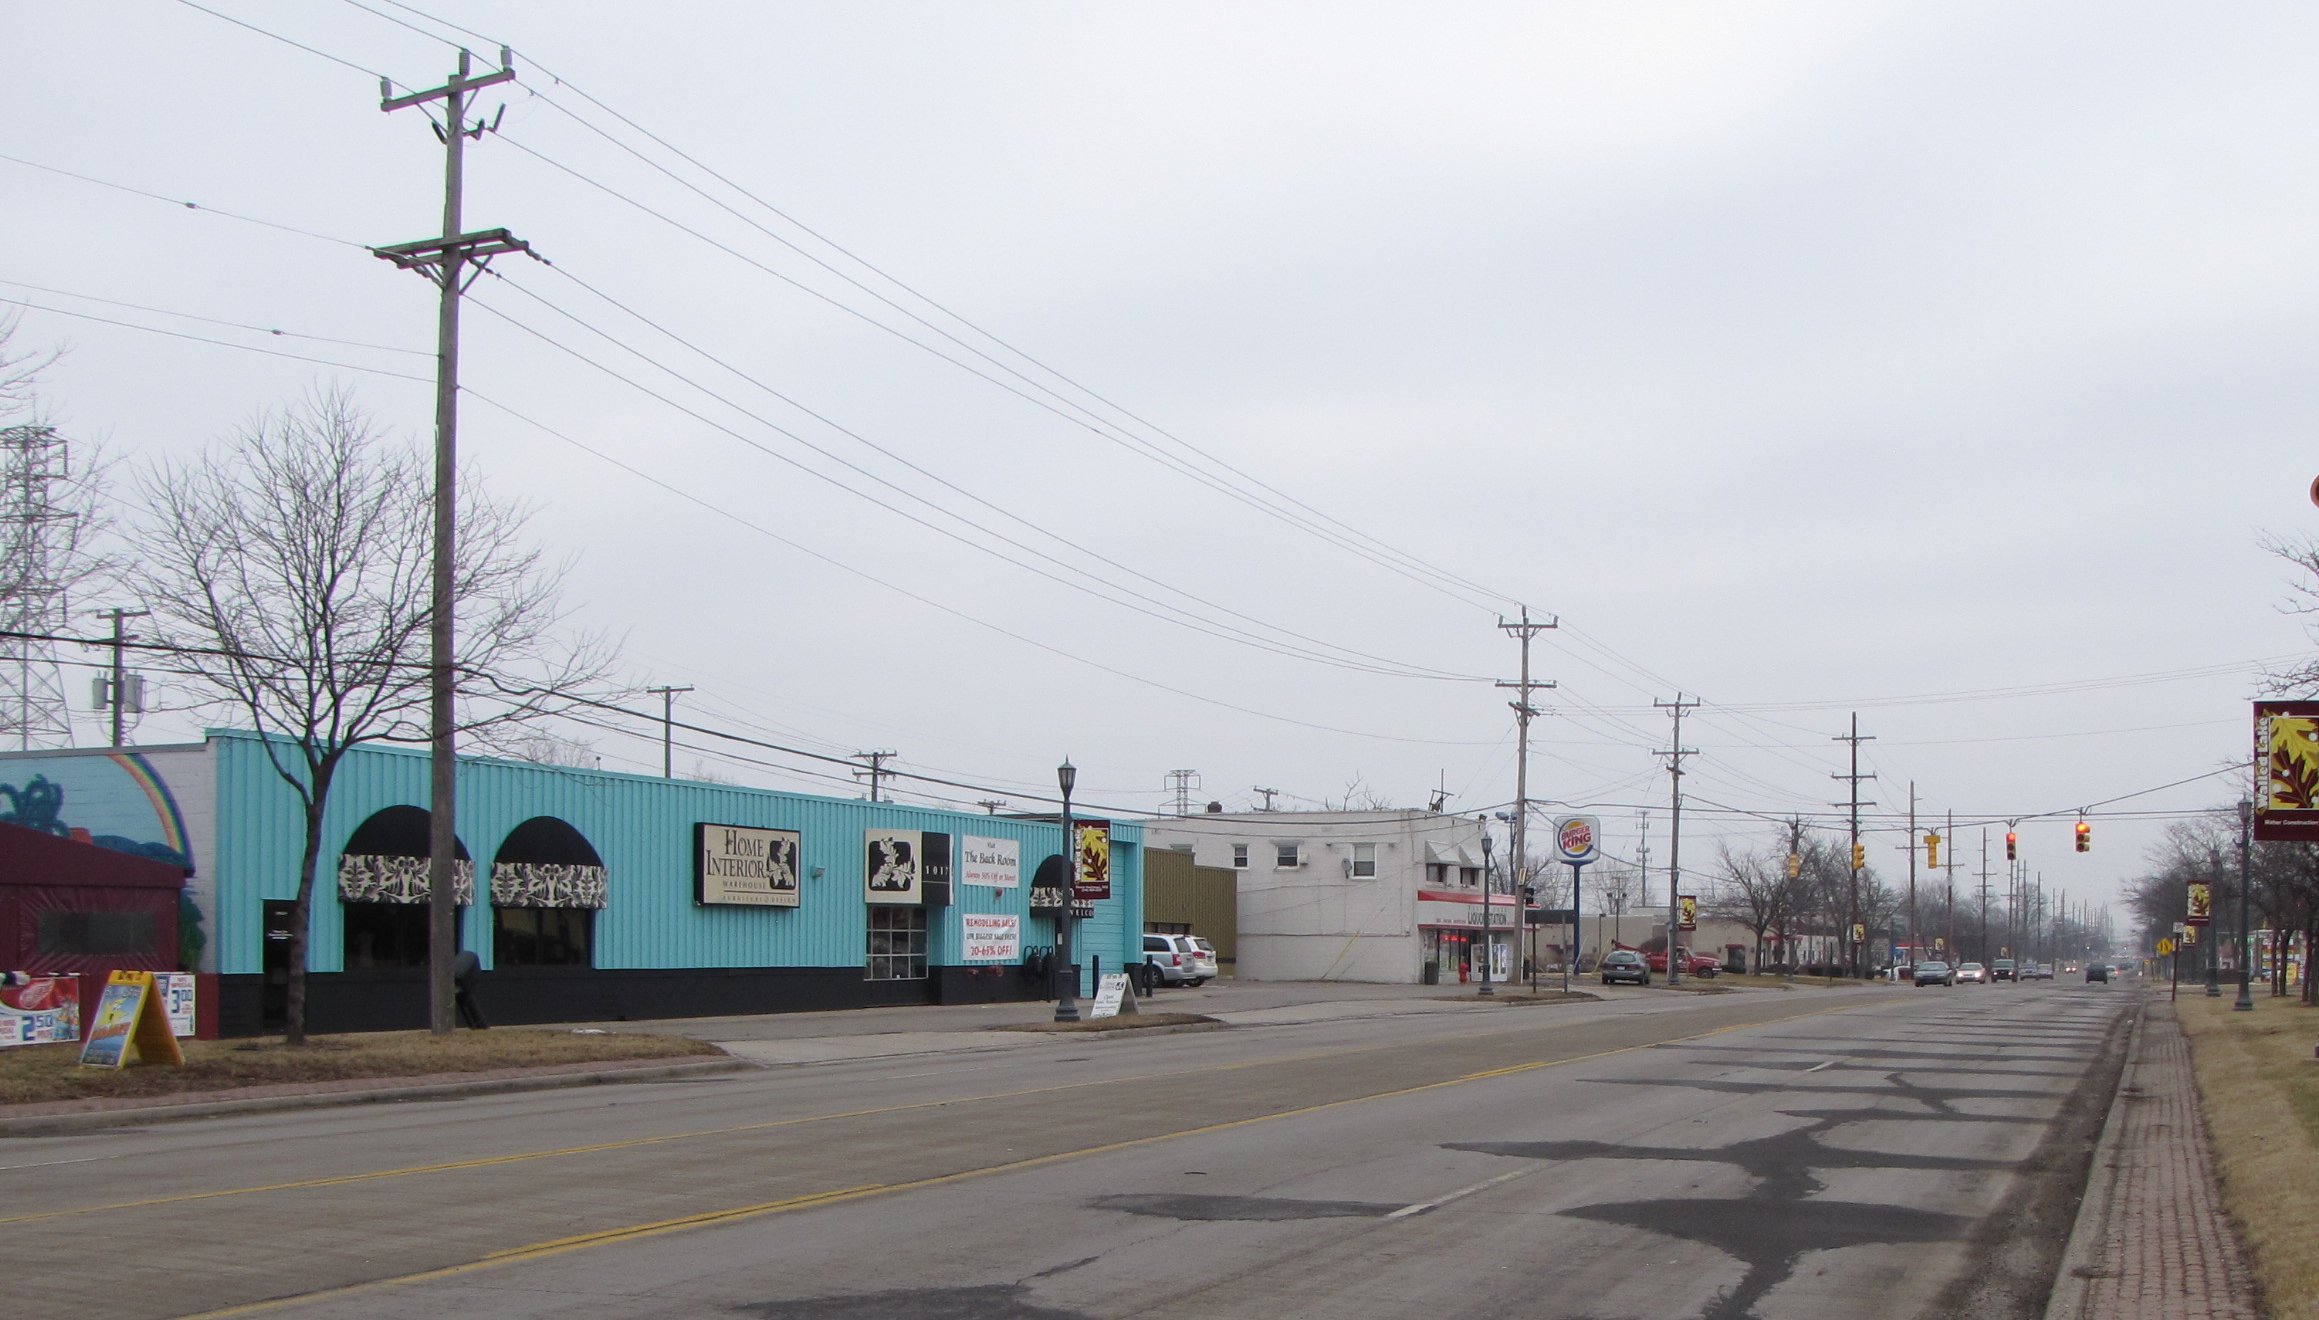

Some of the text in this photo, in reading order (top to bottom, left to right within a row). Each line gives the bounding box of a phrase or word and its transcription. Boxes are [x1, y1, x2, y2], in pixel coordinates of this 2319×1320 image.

[2257, 717, 2268, 808] Walled Lake
[724, 829, 764, 857] HOME
[1561, 825, 1590, 841] BURGER
[1562, 832, 1592, 850] KING
[706, 849, 768, 879] INTERIOR
[965, 850, 1017, 867] The Back Room
